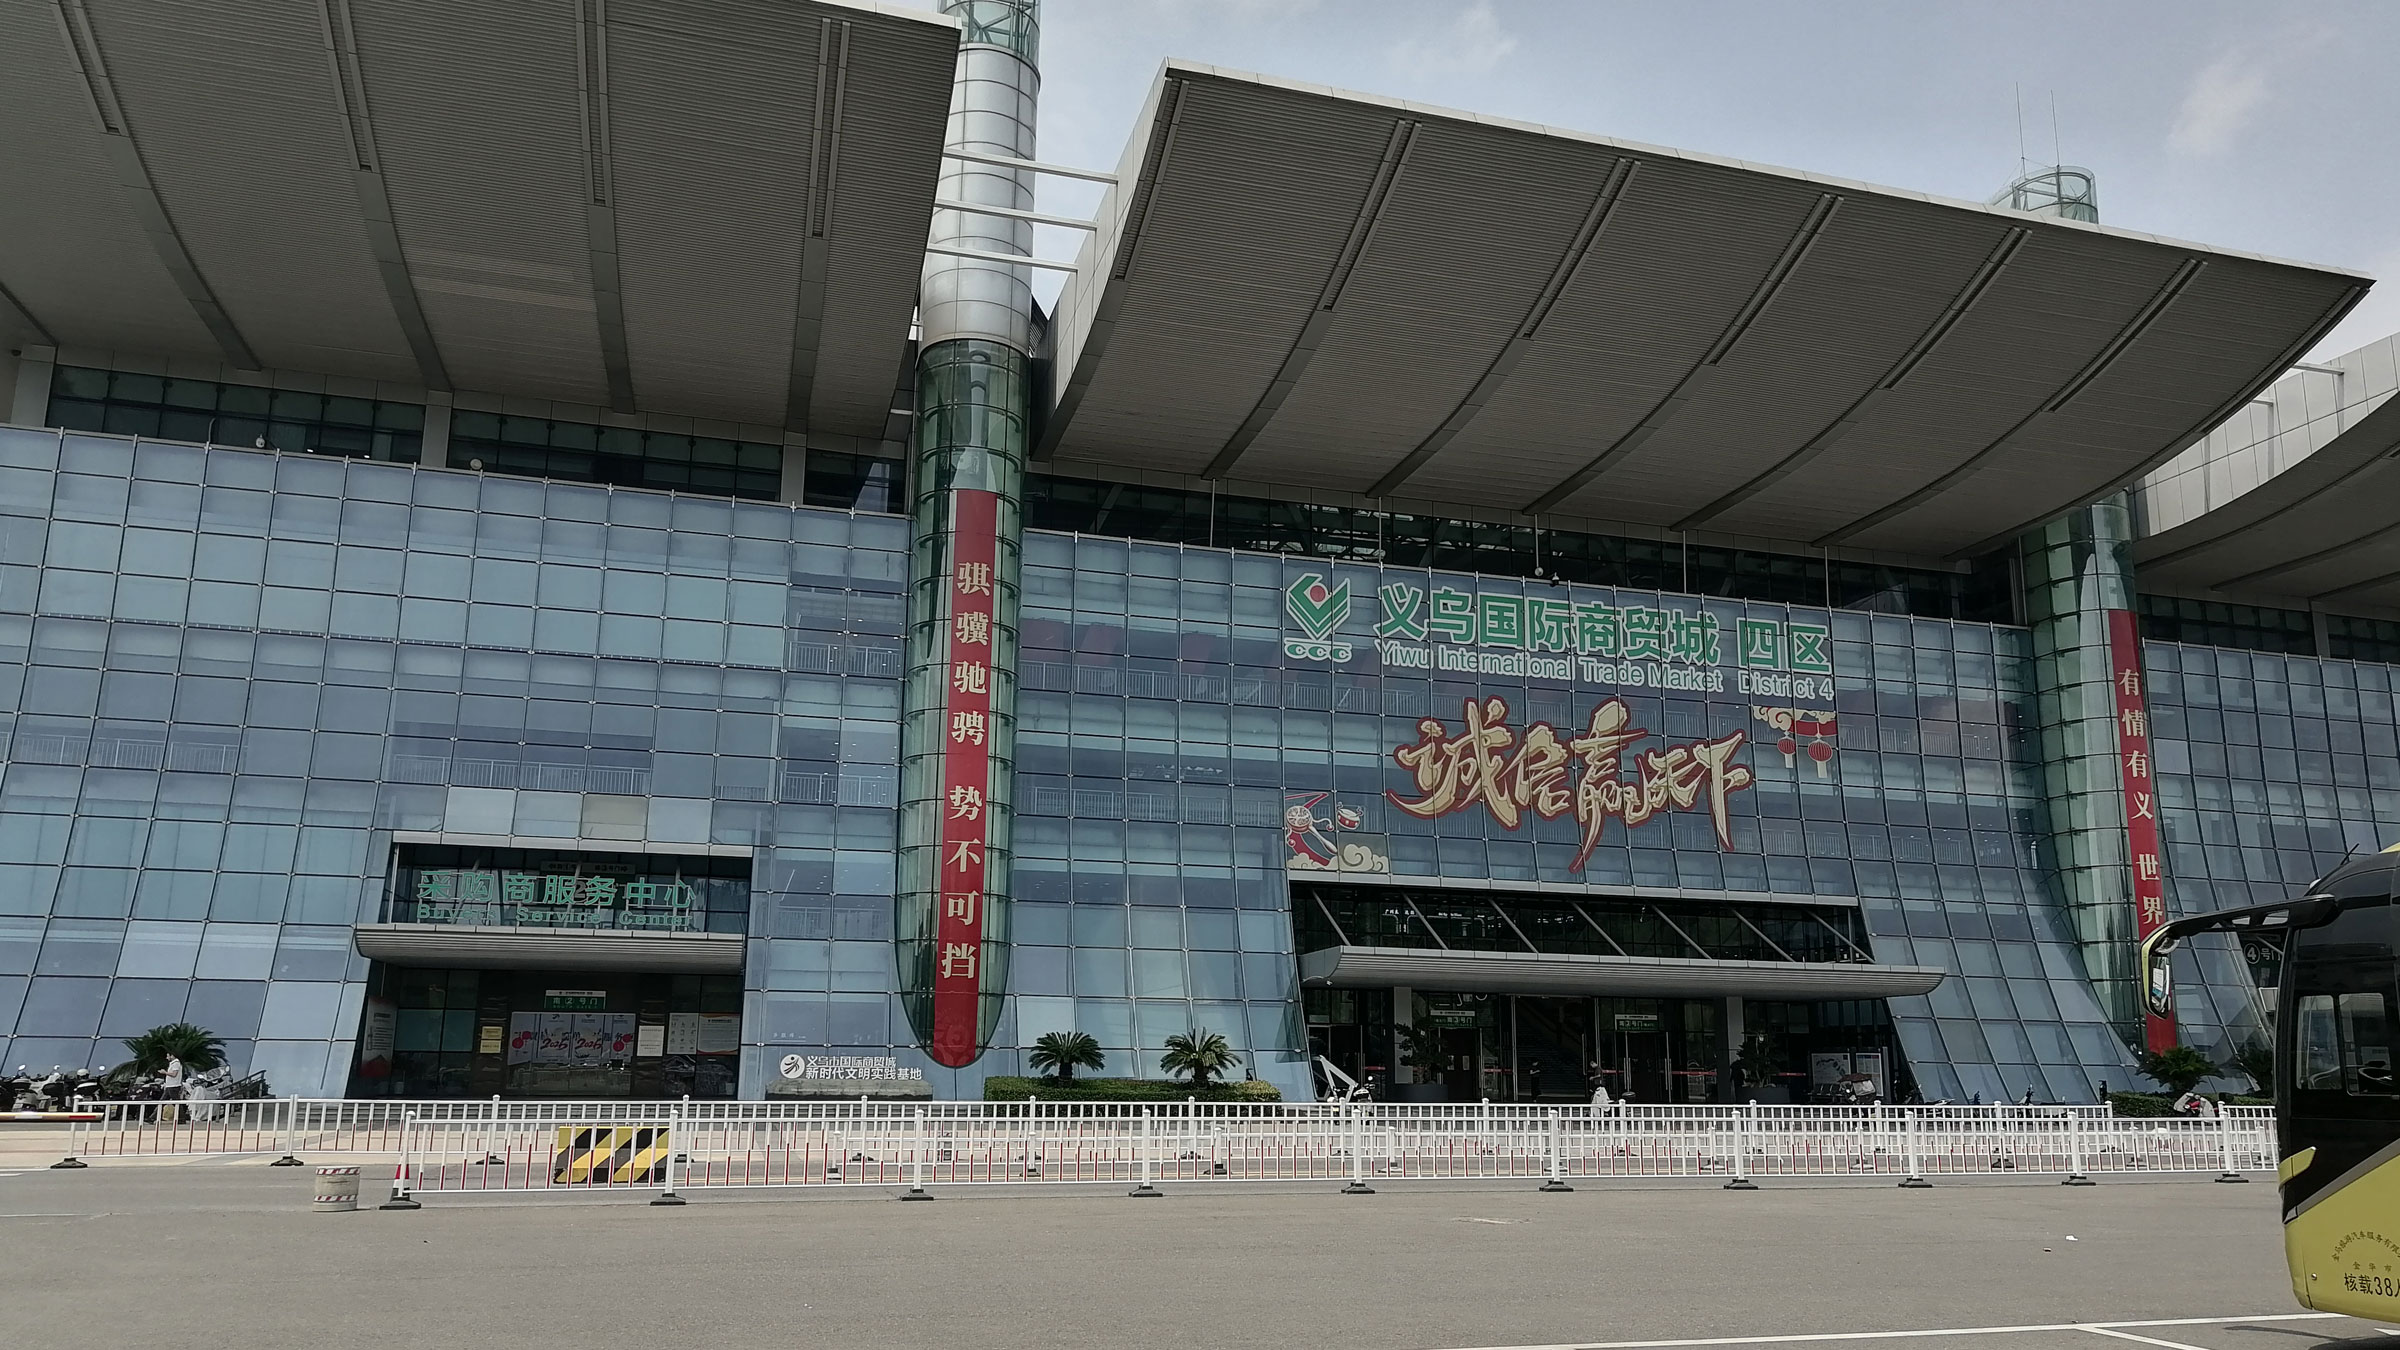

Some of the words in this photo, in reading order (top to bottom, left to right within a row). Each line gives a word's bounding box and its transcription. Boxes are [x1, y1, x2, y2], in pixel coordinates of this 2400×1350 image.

[951, 562, 991, 745] 骐骥驰骋
[1373, 582, 1721, 666] 义乌国际商贸城
[1736, 617, 1832, 674] 四区
[1375, 640, 1433, 669] Yiwu
[1438, 644, 1575, 681] International
[1578, 657, 1644, 687] Trade
[1648, 663, 1724, 692] Market
[1737, 670, 1816, 699] District
[1818, 677, 1834, 701] 4
[1390, 695, 1754, 872] 诚信赢天下
[2118, 668, 2153, 819] 有情有义
[2136, 853, 2164, 925] 世界
[416, 903, 496, 922] Buyers
[515, 906, 601, 923] Service
[618, 910, 693, 926] Center
[417, 871, 697, 909] 采购商服务中心
[941, 785, 982, 979] 势不可挡
[805, 1067, 922, 1080] 新时代文明实践基地
[806, 1055, 897, 1068] 义乌市国际商贸城
